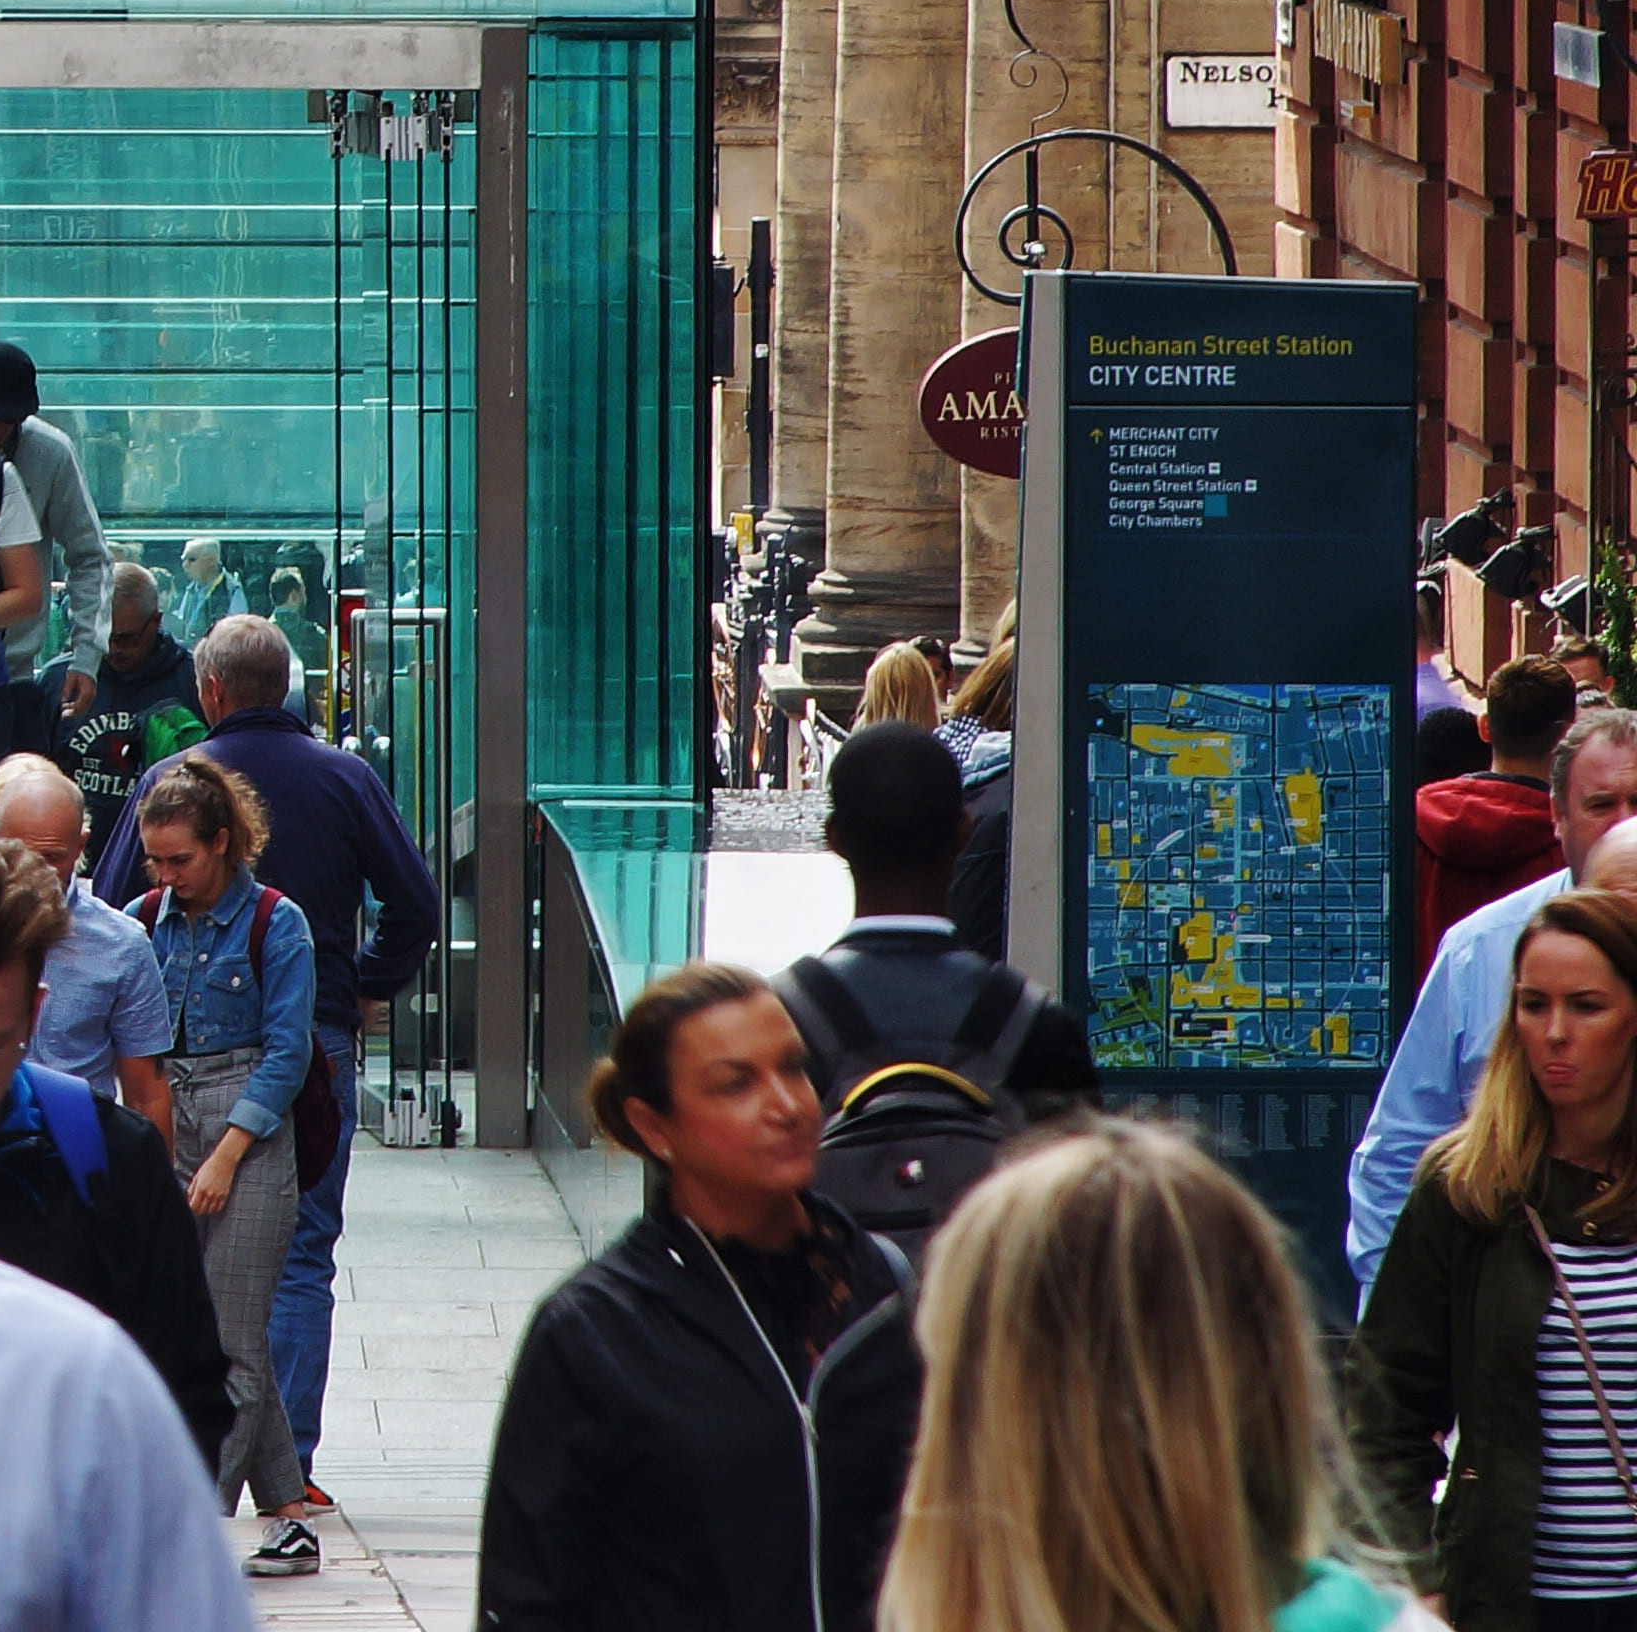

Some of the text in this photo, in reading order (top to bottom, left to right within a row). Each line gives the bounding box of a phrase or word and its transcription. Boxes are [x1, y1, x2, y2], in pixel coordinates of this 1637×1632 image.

[1180, 61, 1274, 83] NELSO
[1089, 335, 1353, 356] Buchanan Street Station
[1089, 365, 1237, 386] CITY CENTRE
[1109, 427, 1219, 441] MERCHANT CITY
[1109, 445, 1177, 457] ST ENOCH
[1109, 462, 1205, 475] Central Station
[1109, 479, 1242, 493] Queen Street Station
[1109, 497, 1204, 512] George Square
[1109, 514, 1203, 530] City Chambers
[69, 712, 137, 755] EDINB
